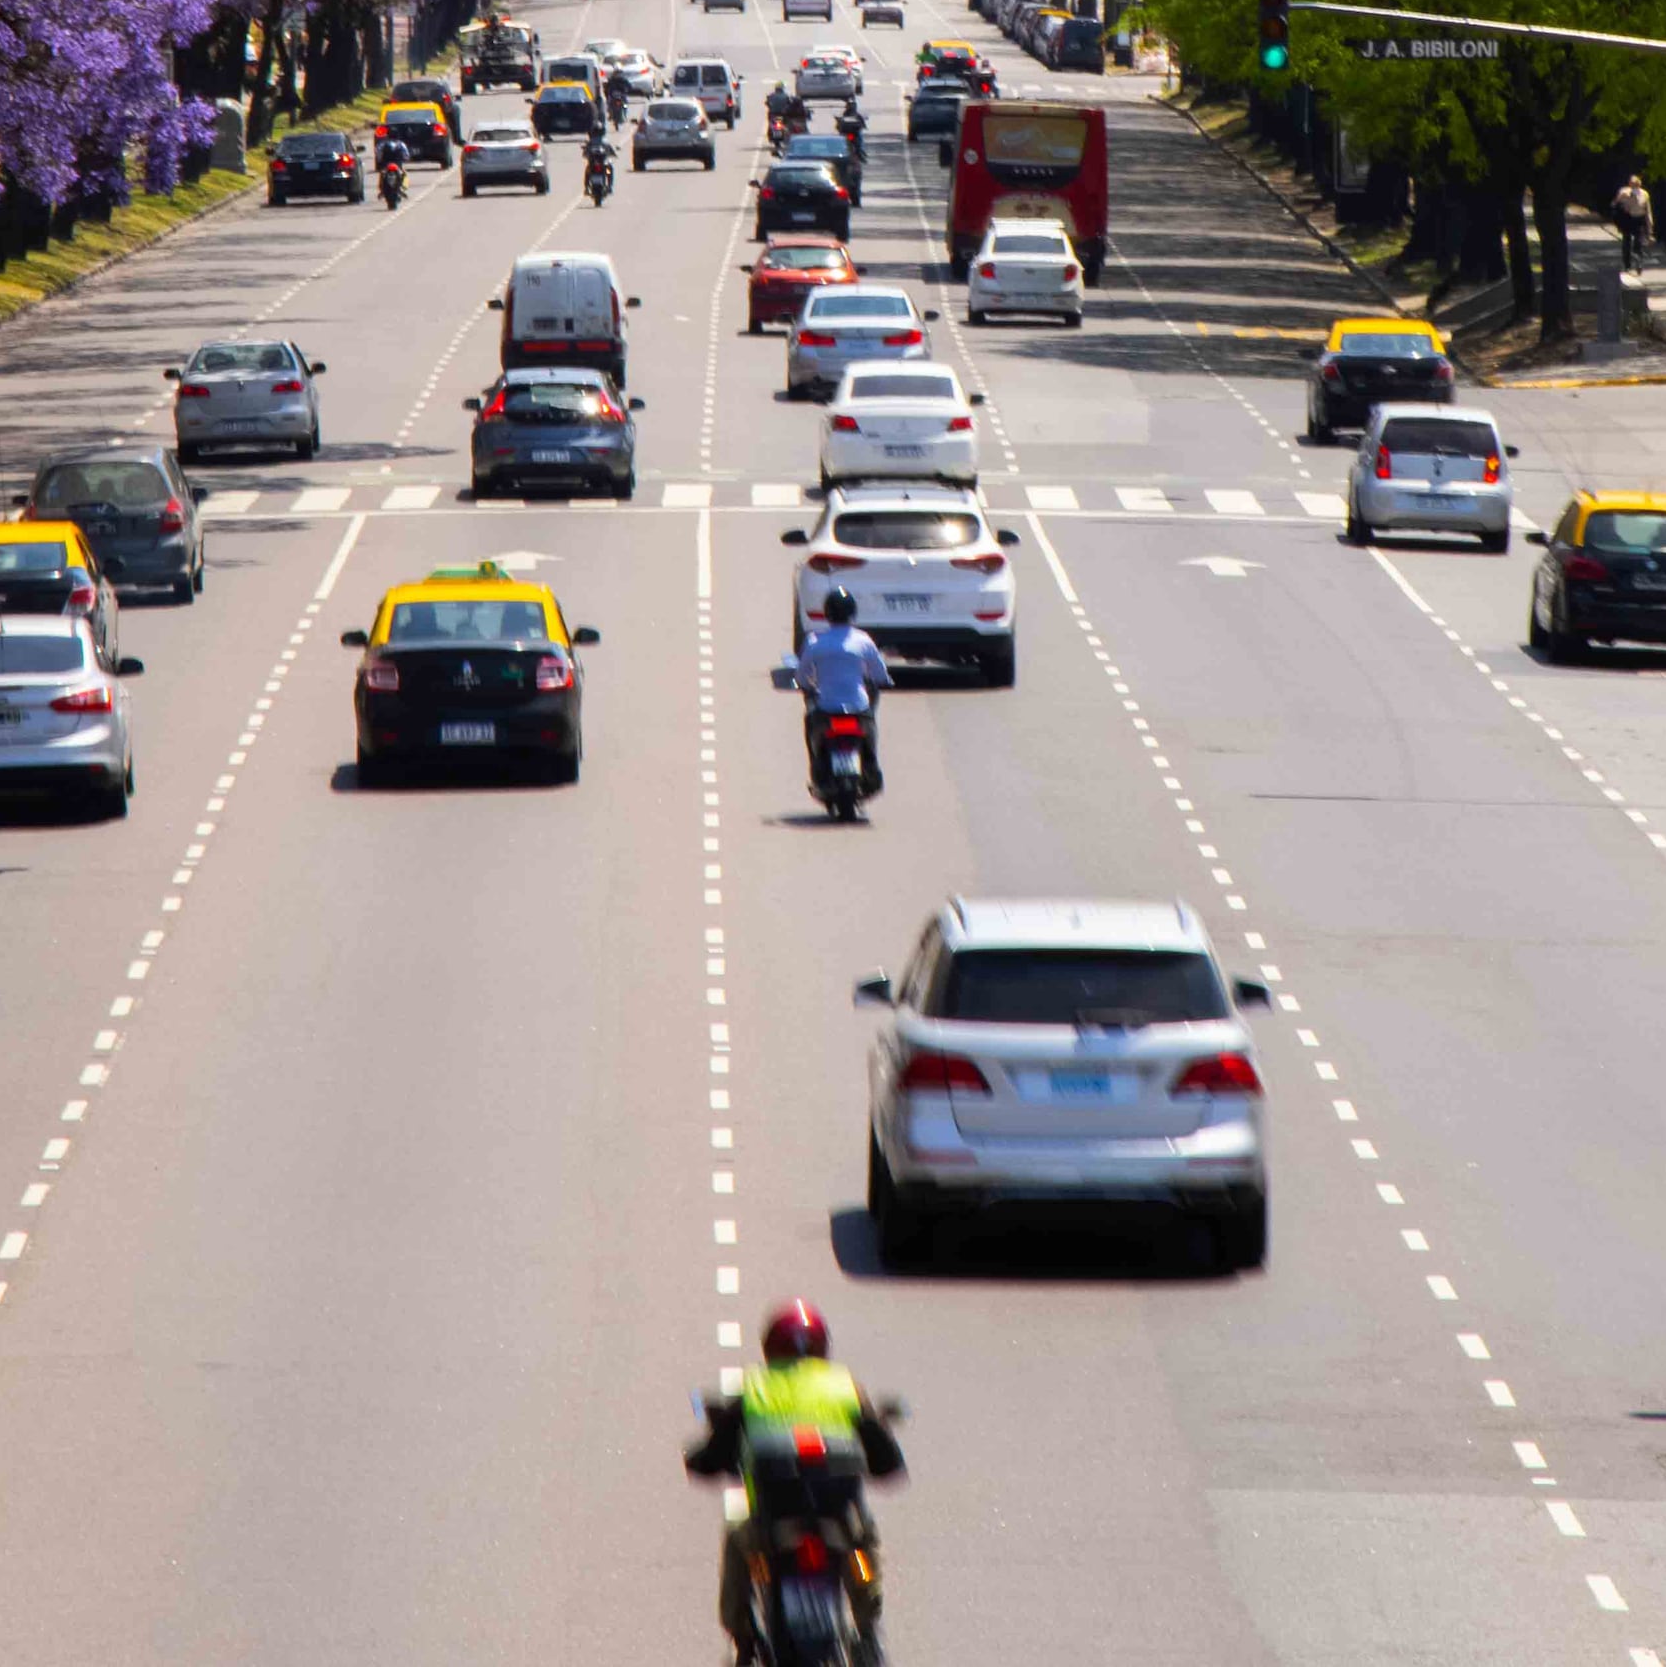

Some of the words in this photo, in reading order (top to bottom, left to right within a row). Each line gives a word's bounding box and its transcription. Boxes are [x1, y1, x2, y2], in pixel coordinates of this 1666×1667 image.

[1362, 40, 1379, 58] J.
[1385, 40, 1405, 58] A.
[1411, 39, 1499, 58] BIBILONI
